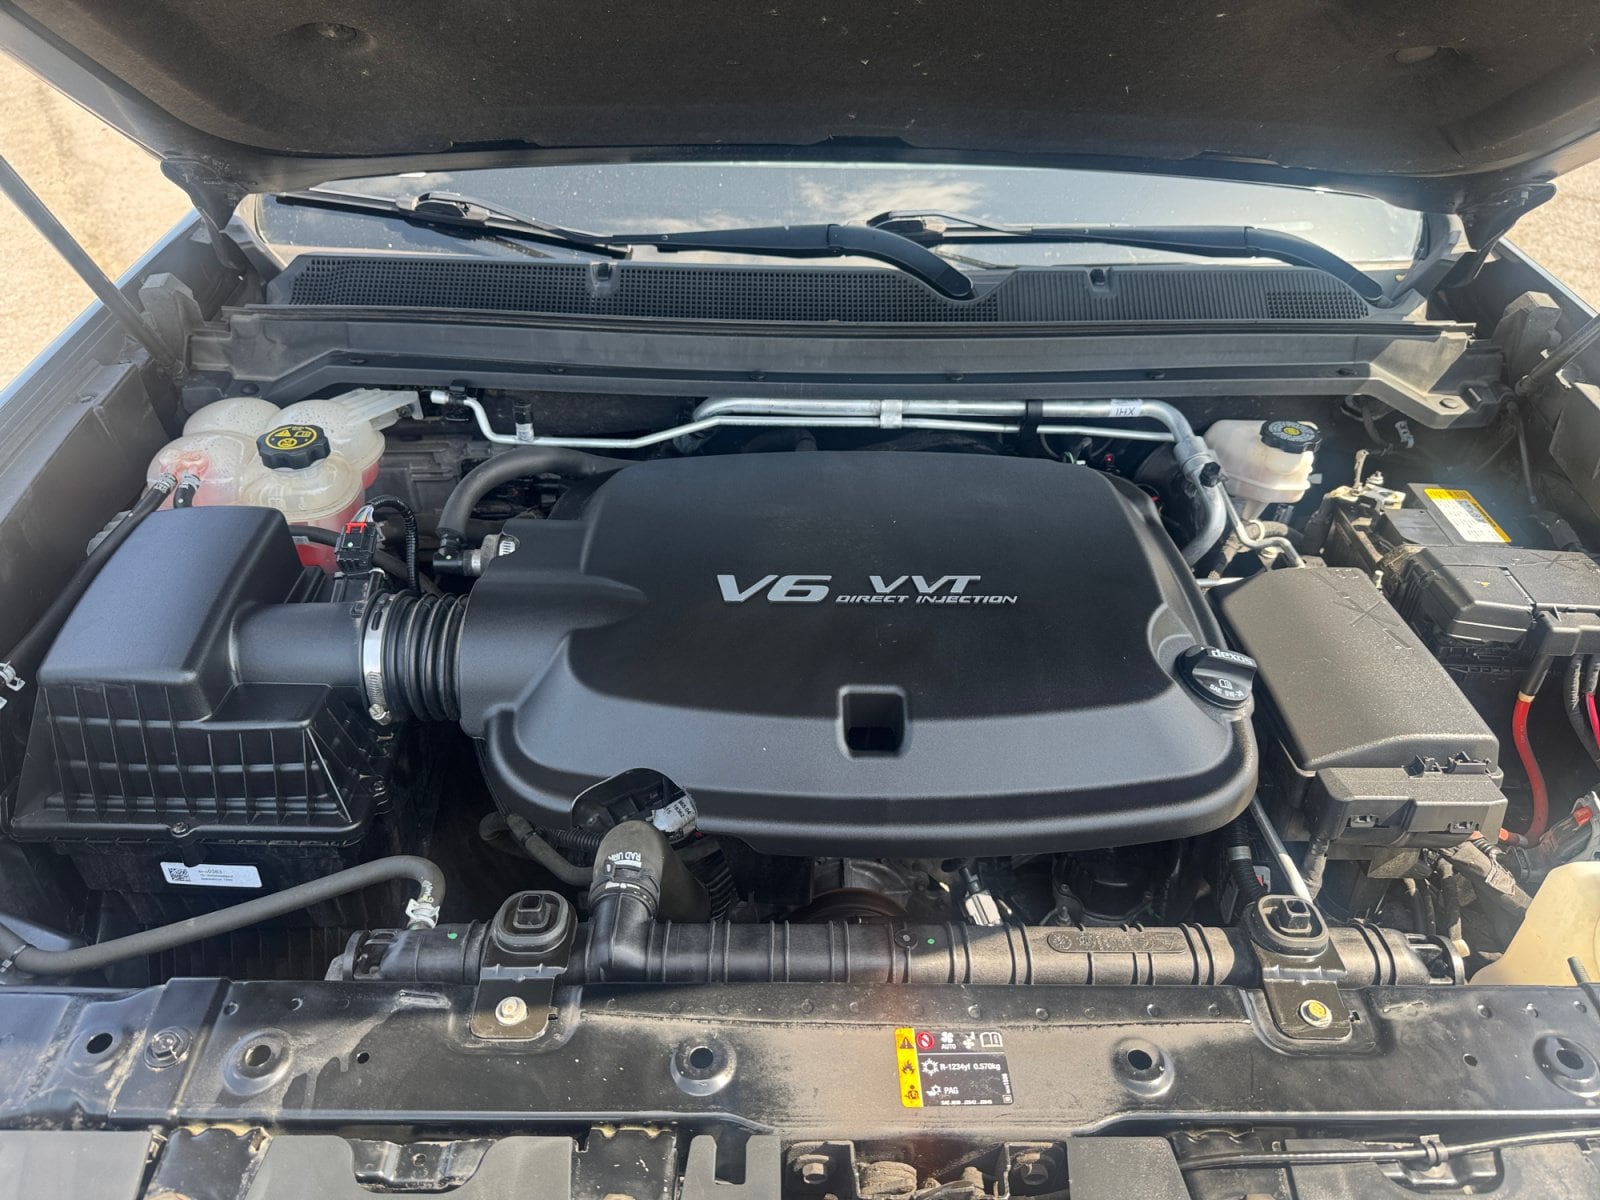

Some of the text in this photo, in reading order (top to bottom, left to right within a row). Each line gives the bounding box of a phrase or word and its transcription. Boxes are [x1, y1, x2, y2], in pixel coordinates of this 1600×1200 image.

[717, 574, 832, 603] V6
[869, 575, 981, 594] VVT
[835, 595, 1018, 604] DIRECT INJECTION
[1211, 648, 1253, 666] dexos
[624, 851, 642, 861] RAD
[940, 1063, 1001, 1071] R-1234yf 0.570kg
